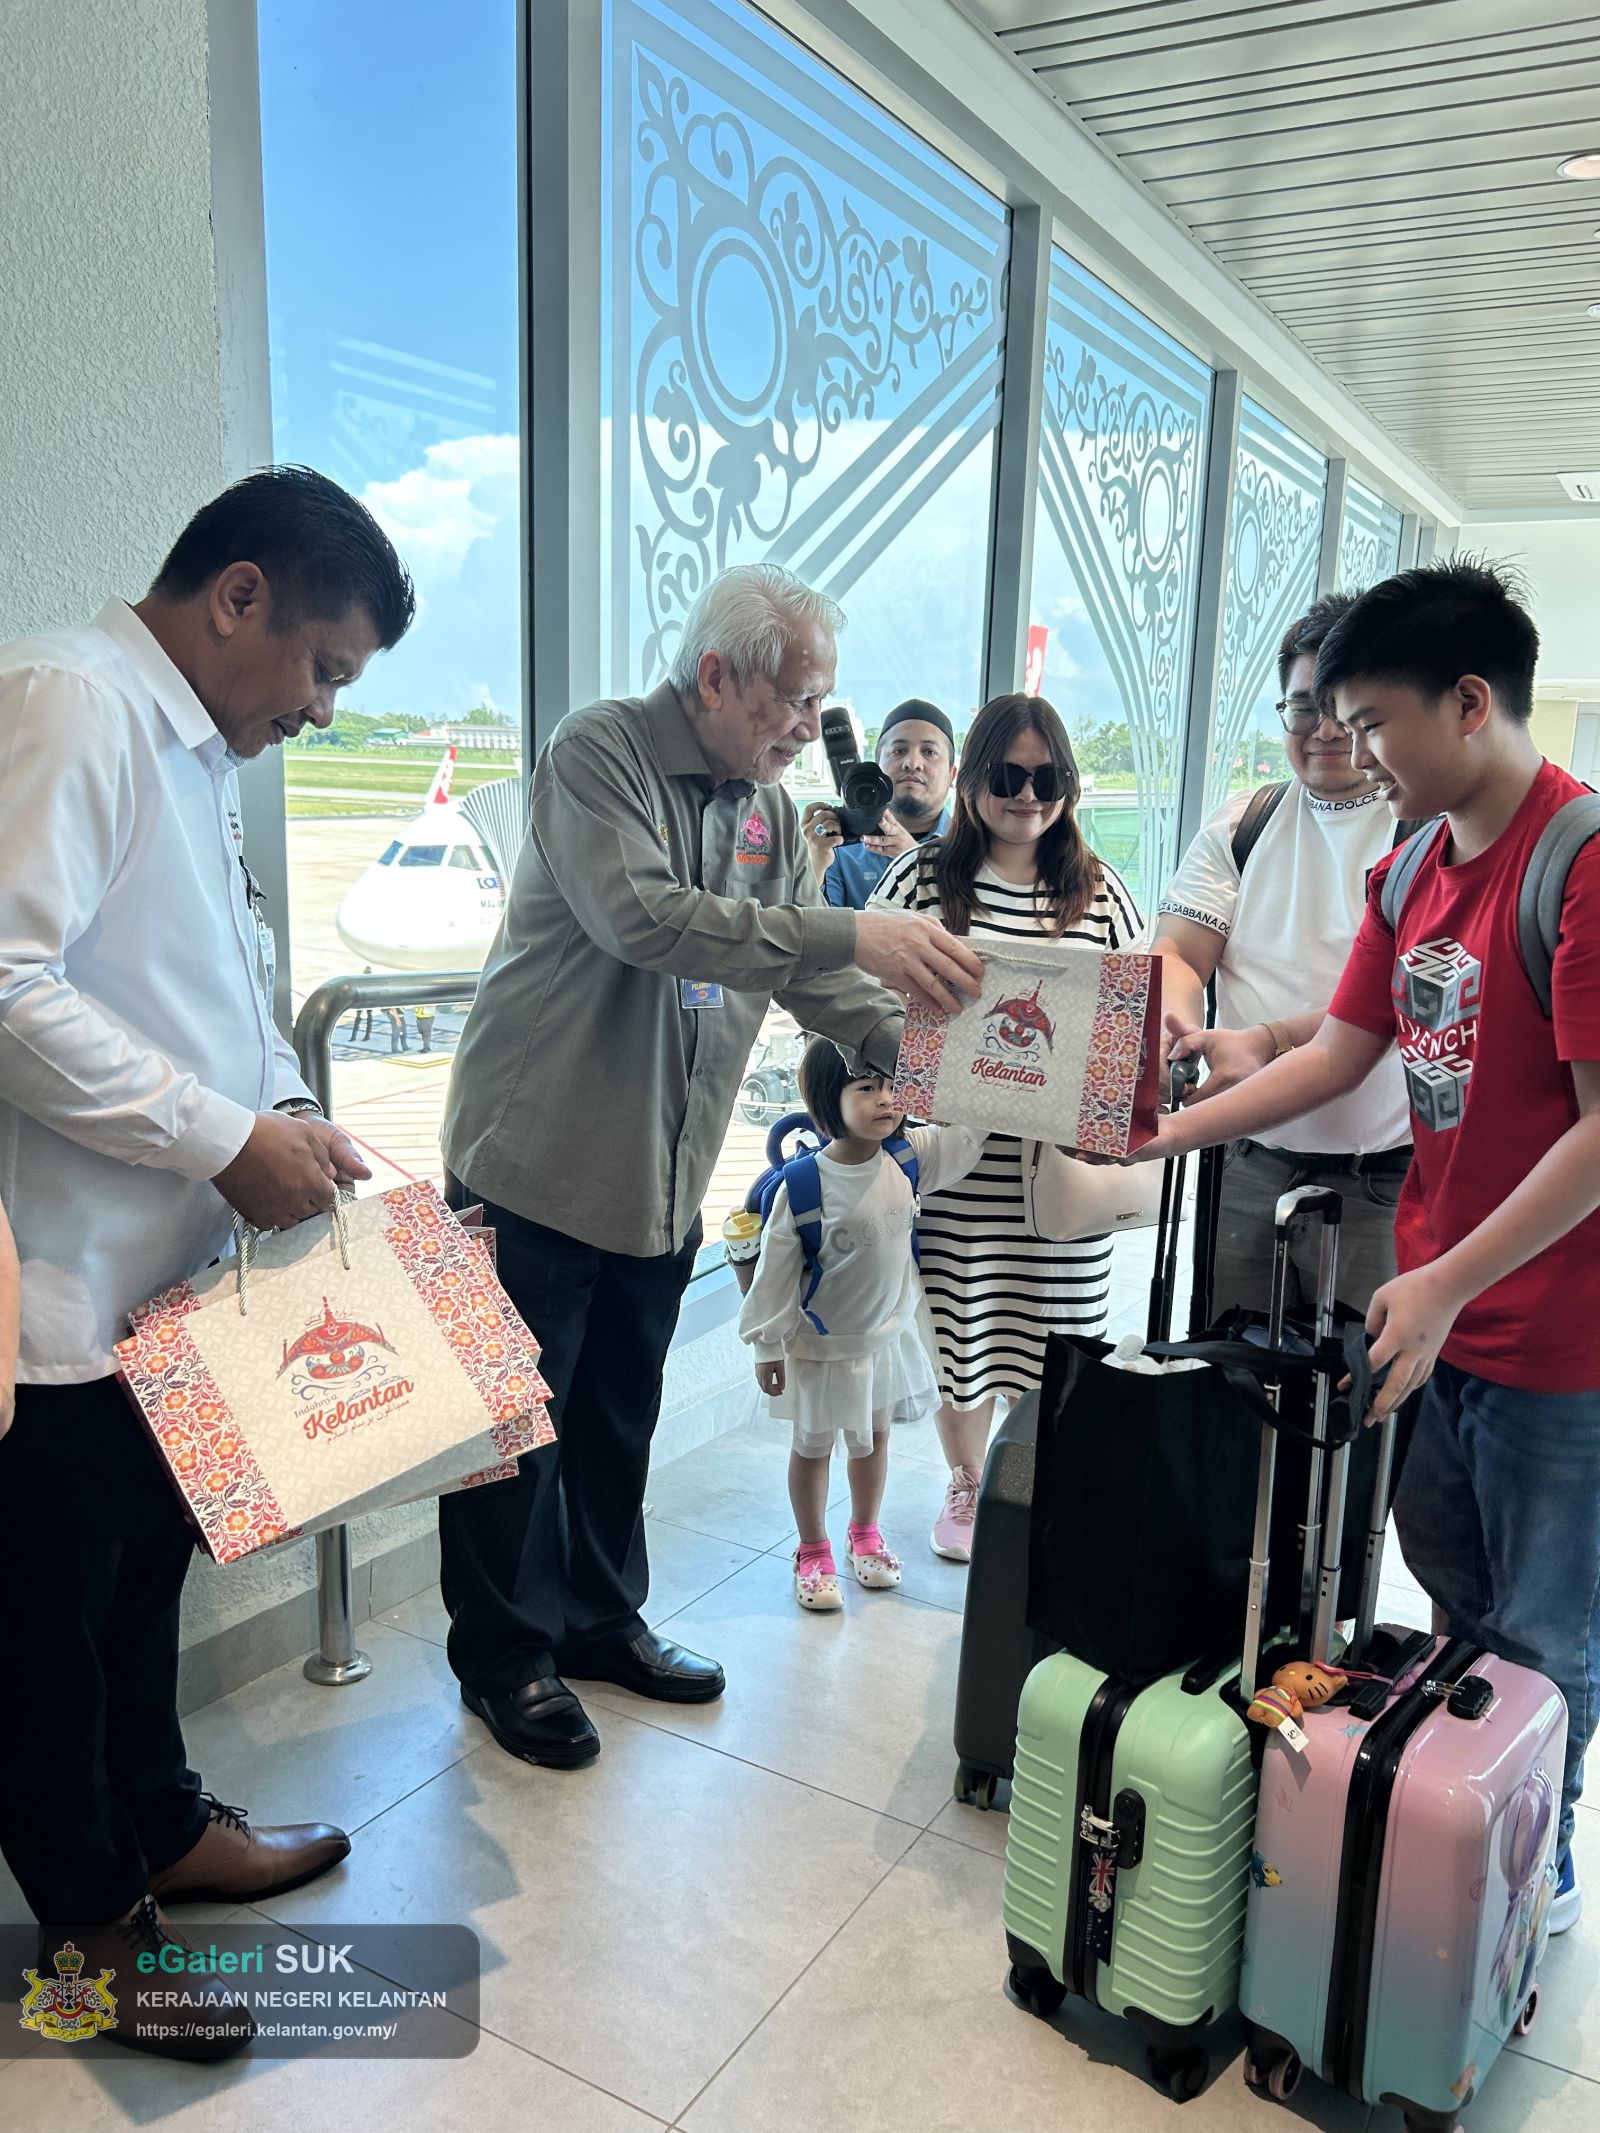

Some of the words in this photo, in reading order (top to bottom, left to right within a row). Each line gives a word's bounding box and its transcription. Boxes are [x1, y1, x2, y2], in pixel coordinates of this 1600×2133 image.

[1334, 792, 1378, 811] DOLCE
[1172, 903, 1217, 927] GABBANA
[1399, 1014, 1477, 1058] IVENCH
[971, 1058, 1047, 1086] Kelantan
[294, 1393, 338, 1419] Indahnya
[303, 1379, 414, 1440] Kelantan
